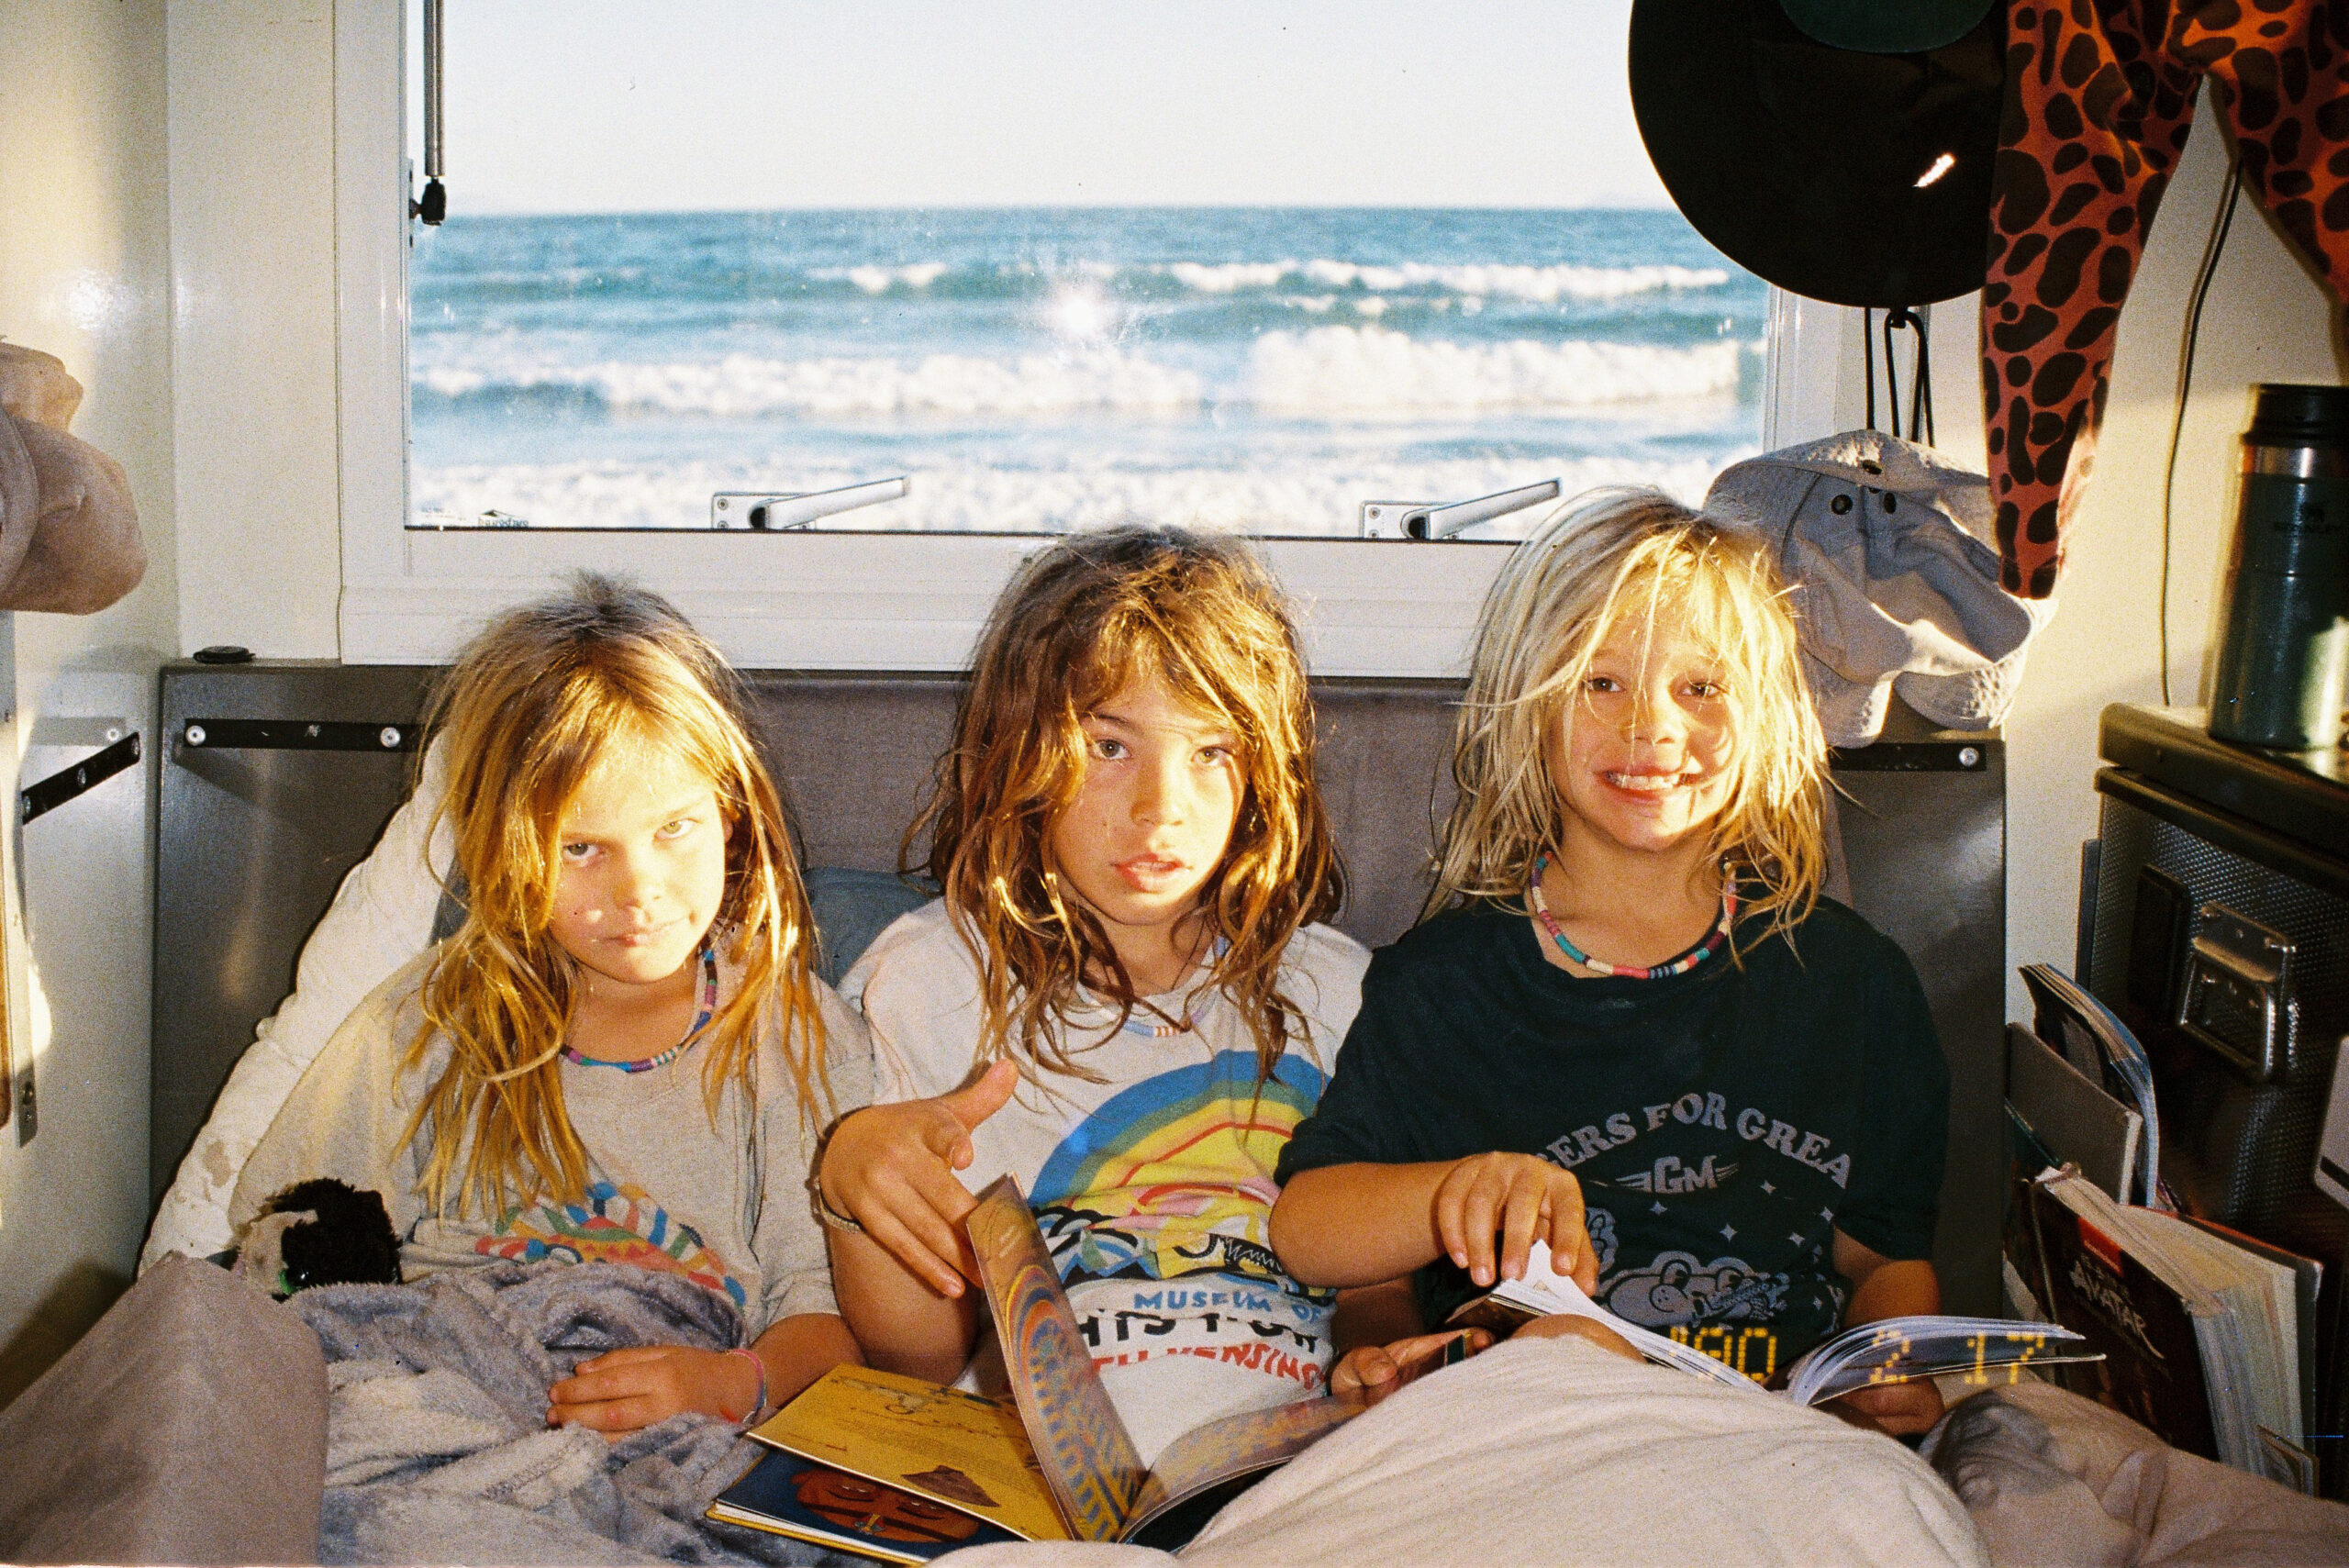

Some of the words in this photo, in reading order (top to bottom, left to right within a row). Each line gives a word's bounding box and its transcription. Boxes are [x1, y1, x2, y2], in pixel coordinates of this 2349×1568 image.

[1537, 1113, 1637, 1169] ERS
[1643, 1092, 1727, 1131] FOR
[1736, 1107, 1852, 1190] GREA
[1654, 1155, 1718, 1194] GM
